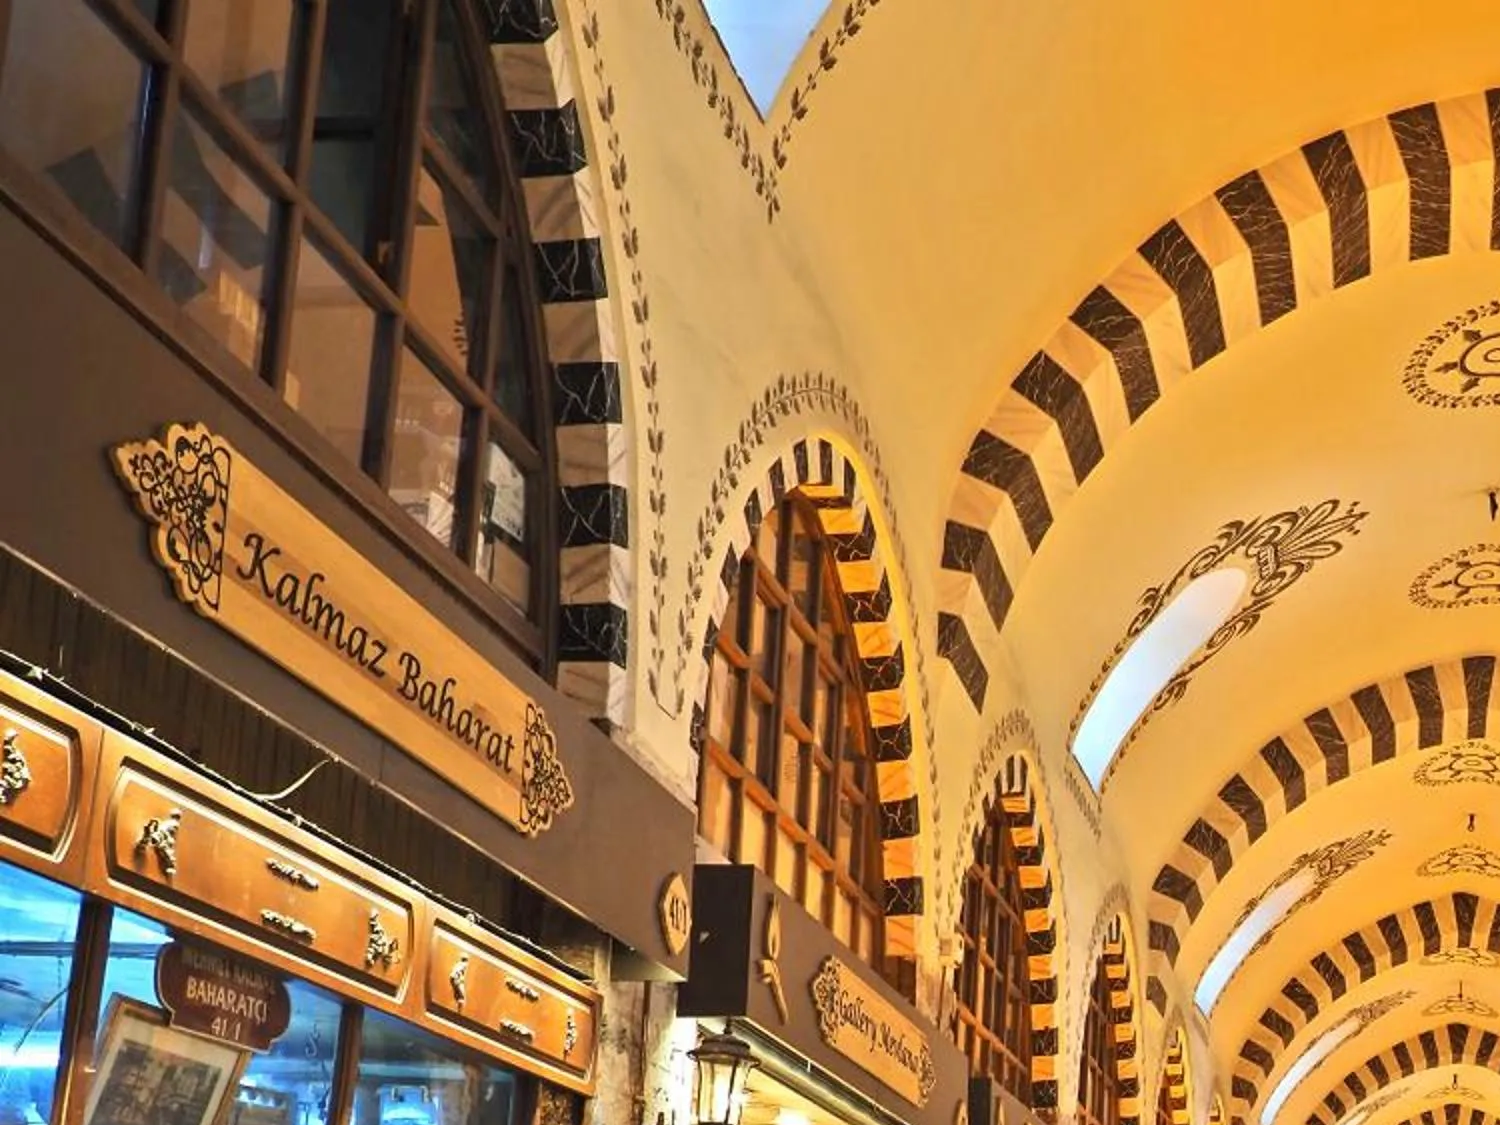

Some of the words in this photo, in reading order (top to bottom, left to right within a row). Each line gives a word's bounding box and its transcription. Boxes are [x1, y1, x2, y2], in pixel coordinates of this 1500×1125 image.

[237, 533, 388, 679] Kalmaz
[396, 651, 517, 773] Baharat
[839, 989, 878, 1054] Gallery
